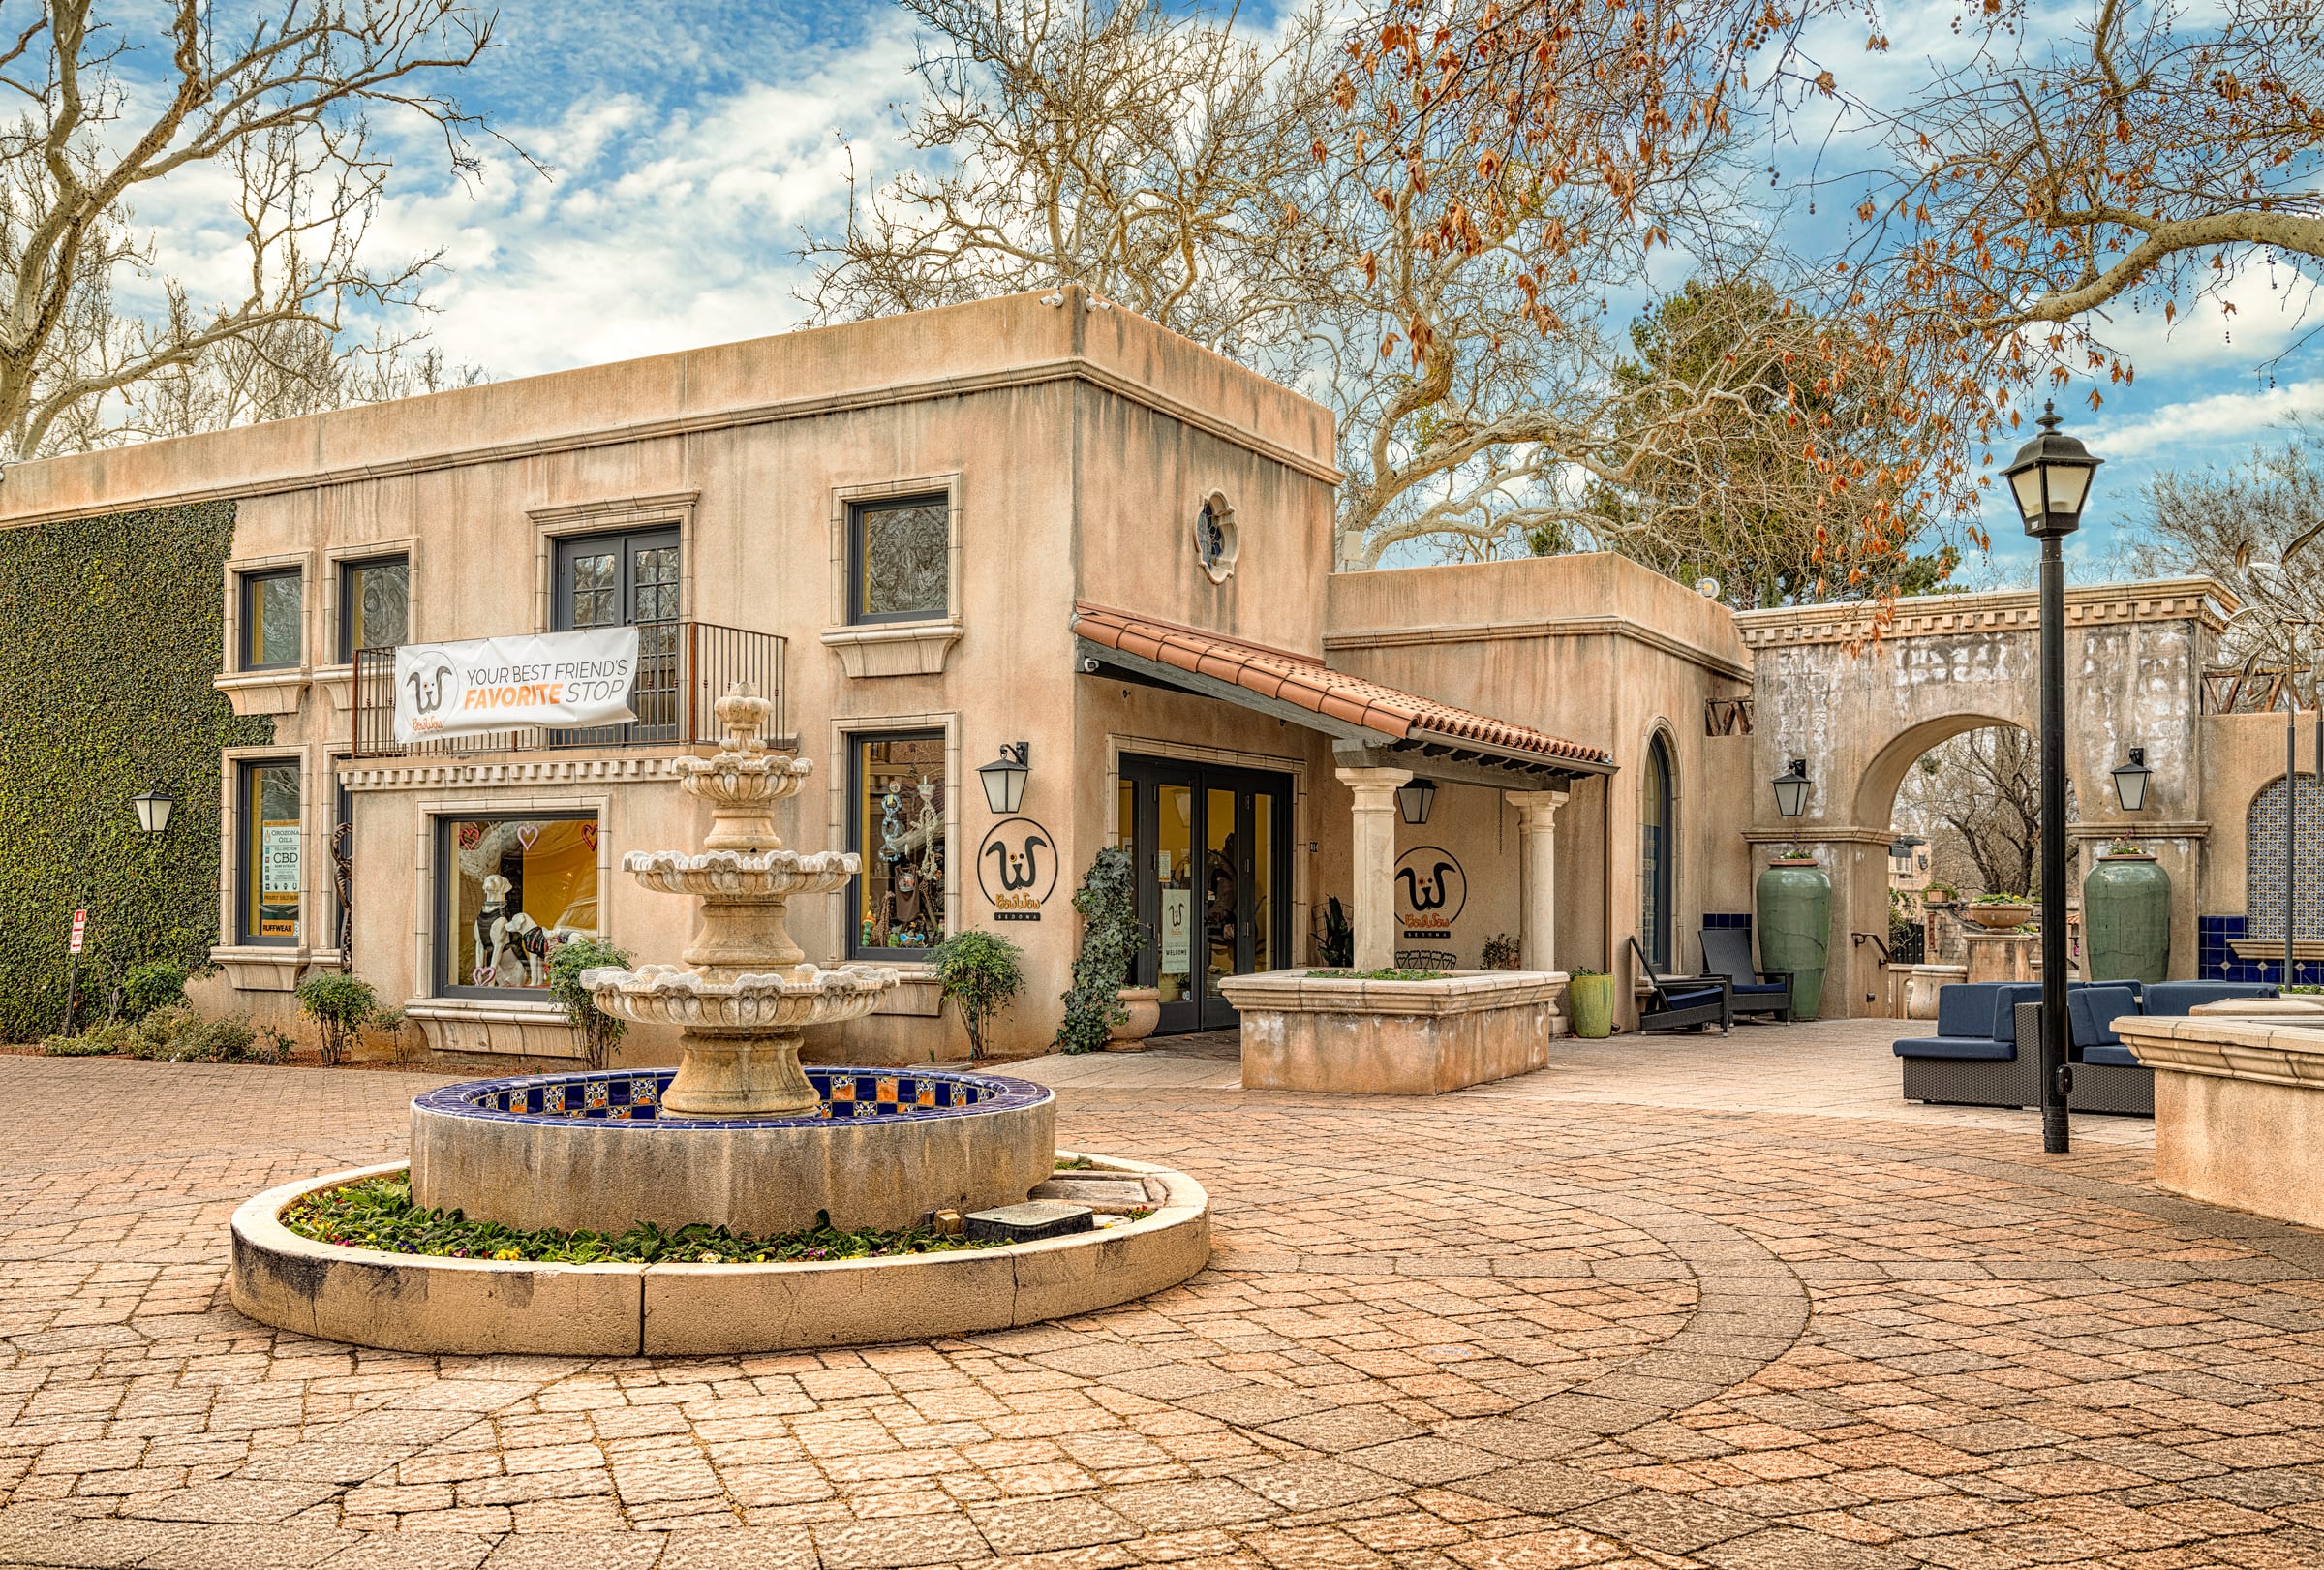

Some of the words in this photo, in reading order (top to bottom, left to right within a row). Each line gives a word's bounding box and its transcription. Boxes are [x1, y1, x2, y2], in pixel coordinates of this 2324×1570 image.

[467, 667, 509, 686] YOUR
[512, 664, 551, 683] BEST
[555, 659, 627, 680] FRIEND'S
[464, 683, 564, 710] FAVORITE
[565, 679, 624, 703] STOP
[273, 852, 298, 864] CBD
